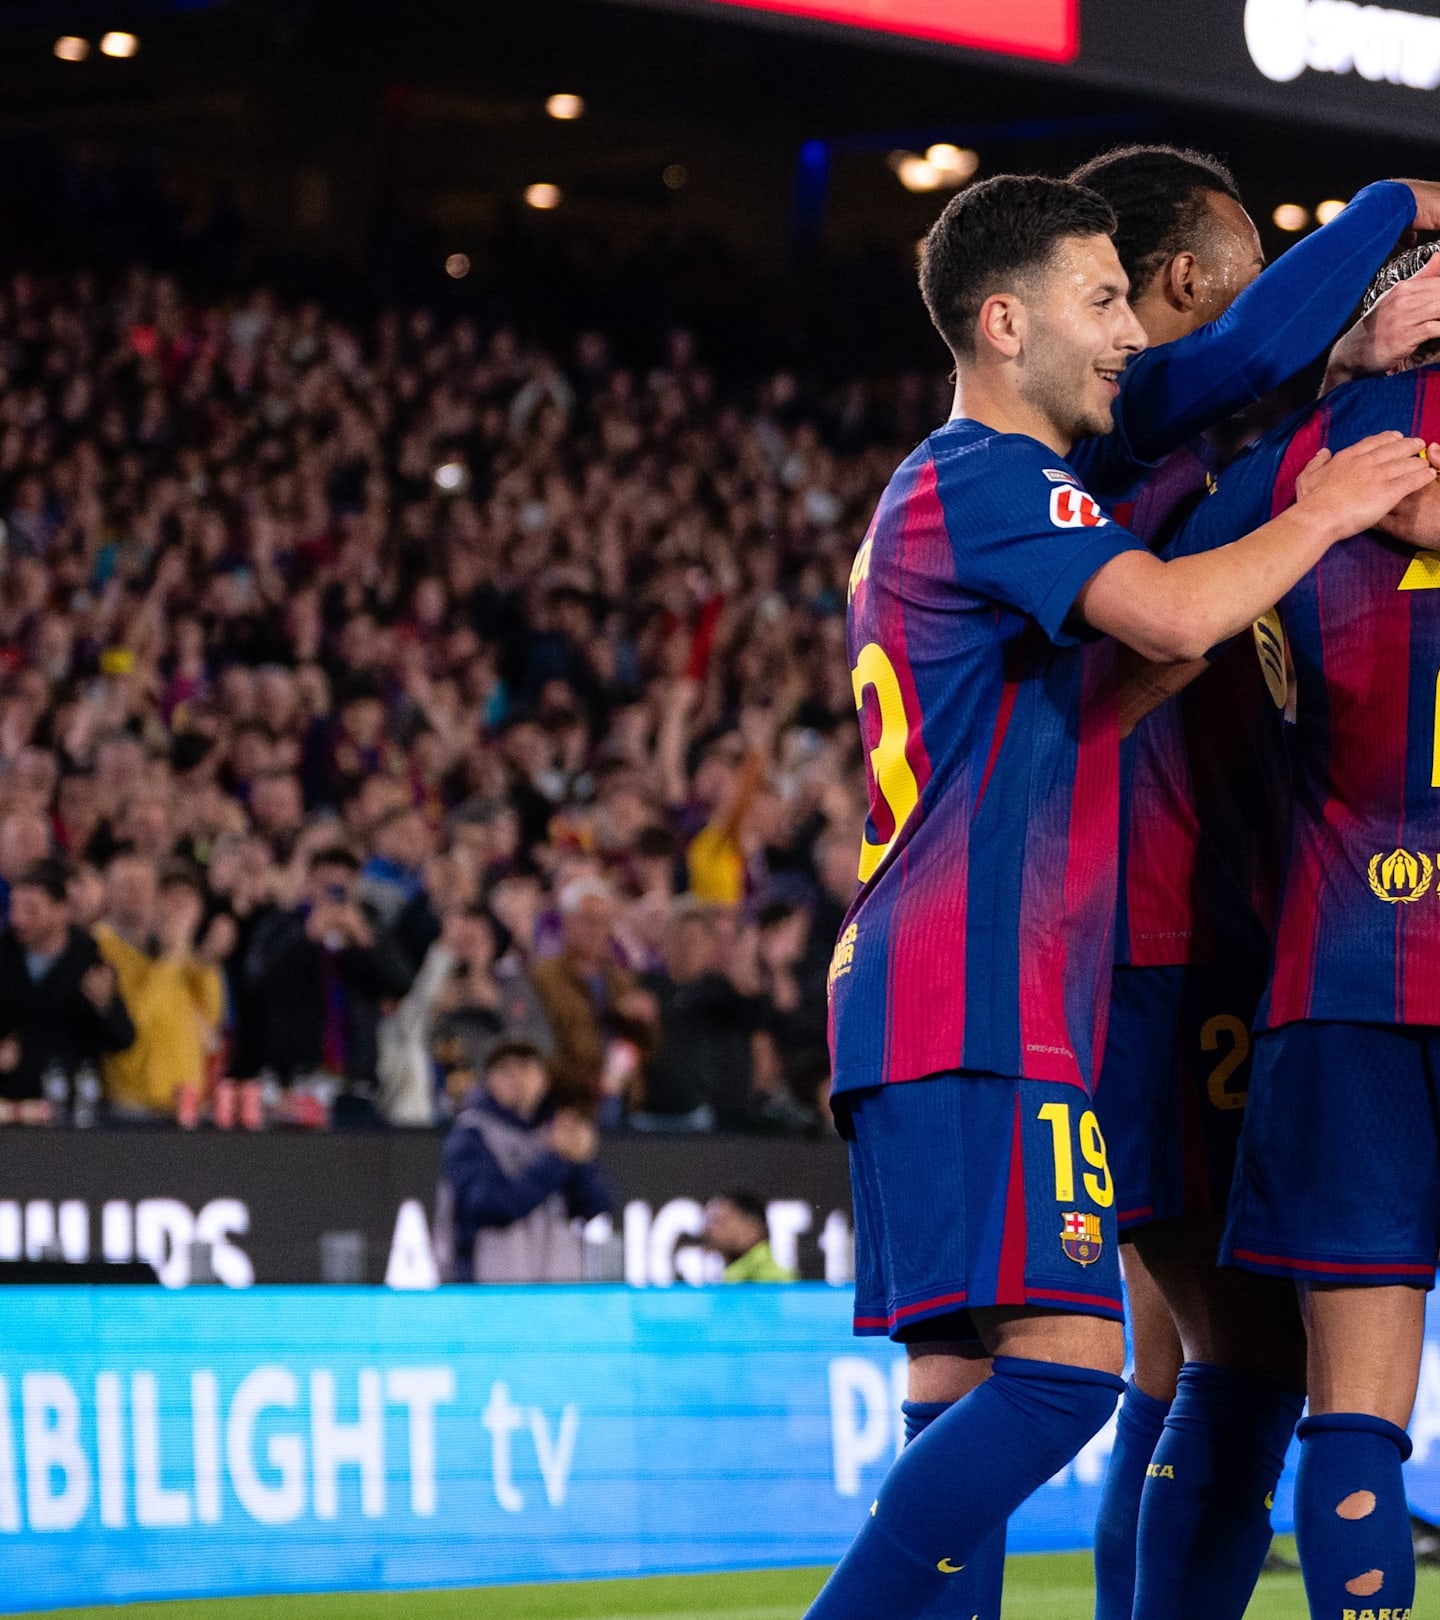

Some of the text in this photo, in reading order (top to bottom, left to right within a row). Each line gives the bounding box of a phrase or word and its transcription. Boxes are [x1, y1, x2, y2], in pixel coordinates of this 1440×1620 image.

[1037, 1102, 1114, 1208] 19
[0, 1366, 579, 1534] BILIGHT tv
